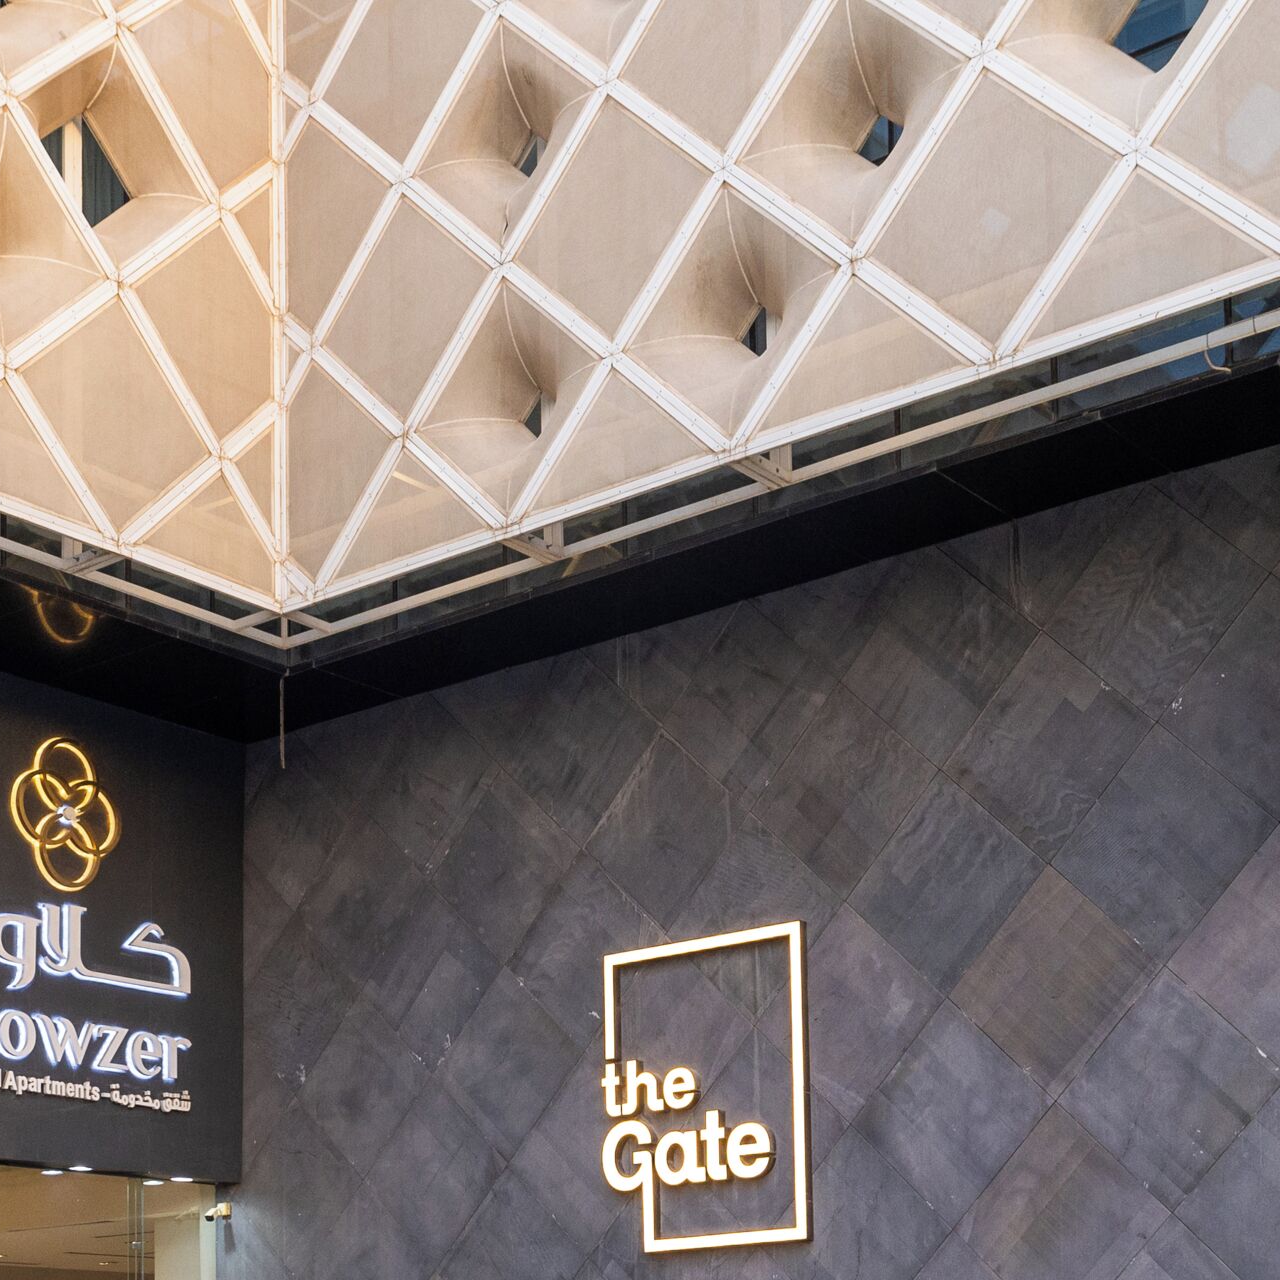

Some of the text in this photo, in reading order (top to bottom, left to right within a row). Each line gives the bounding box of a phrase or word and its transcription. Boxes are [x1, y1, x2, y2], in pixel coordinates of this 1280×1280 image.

[2, 1070, 100, 1101] Apartments
[601, 1058, 701, 1118] the
[601, 1108, 777, 1194] Gate
